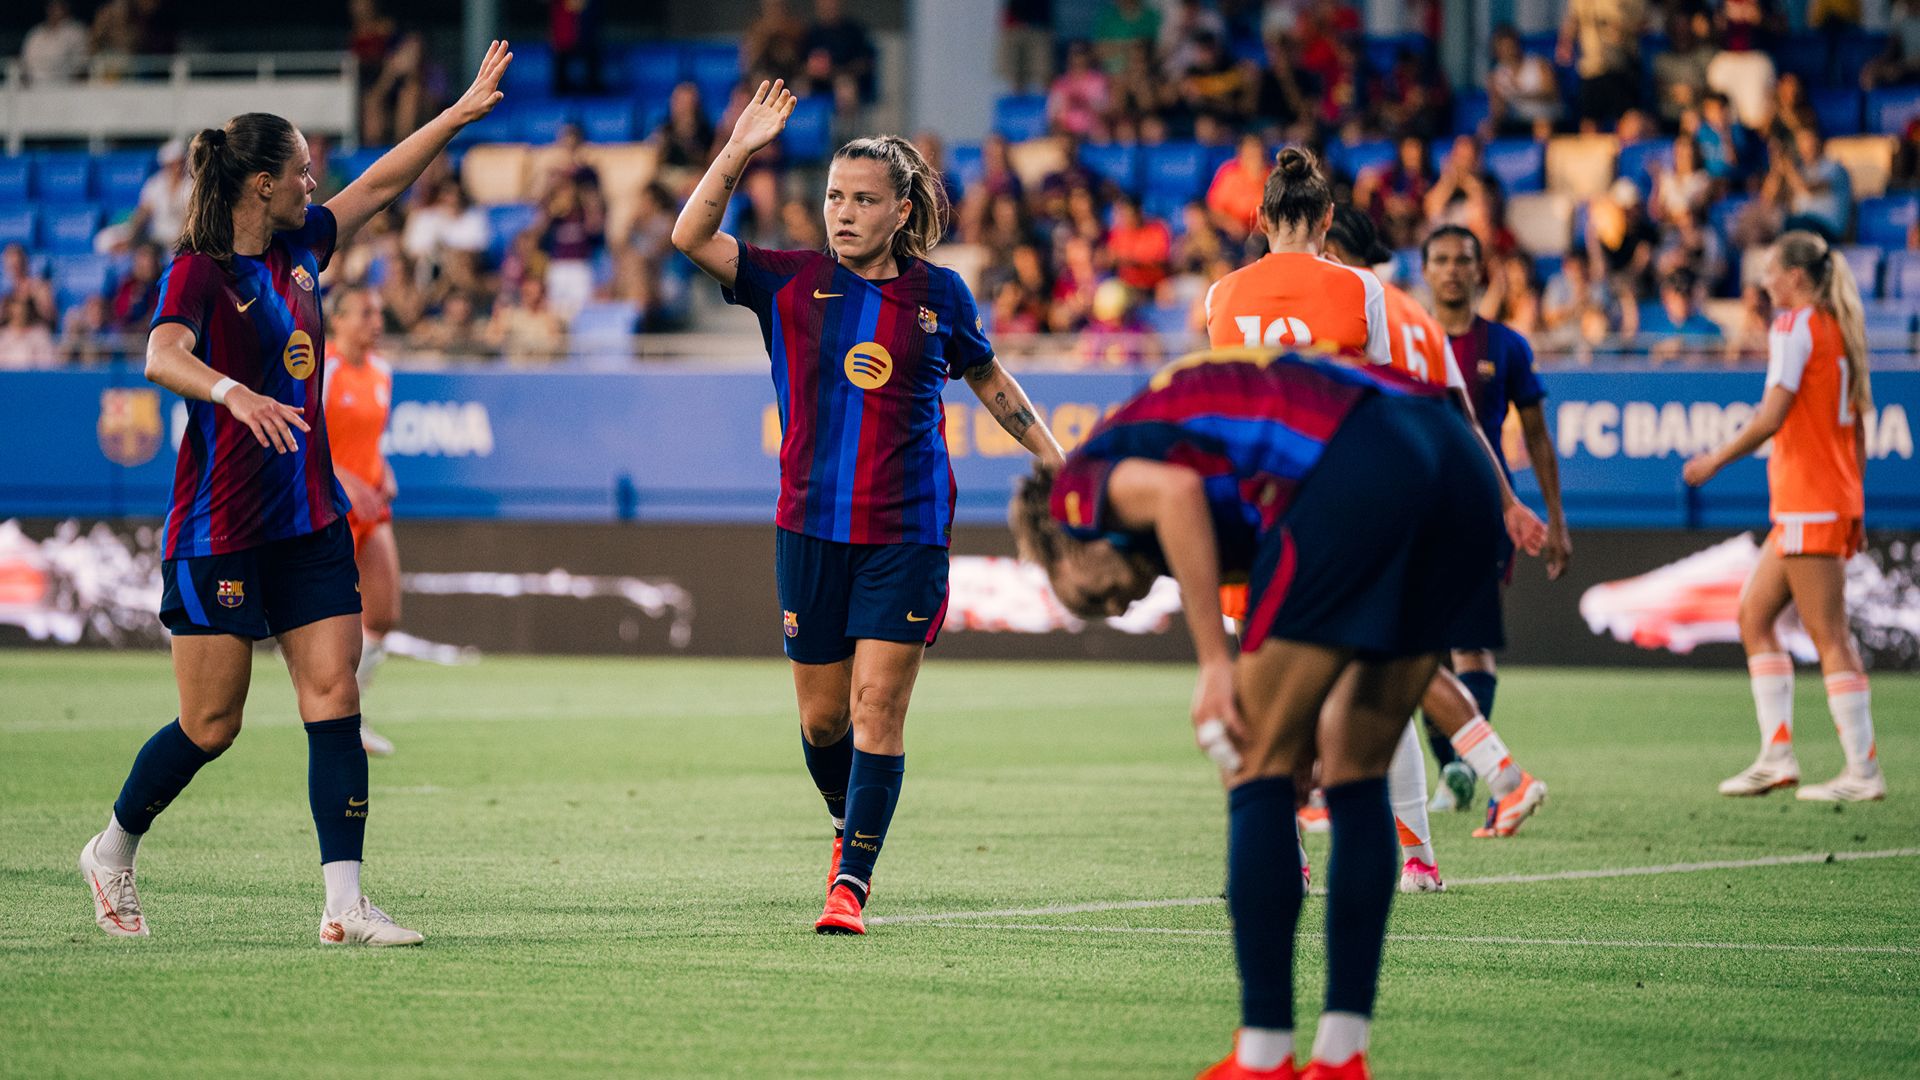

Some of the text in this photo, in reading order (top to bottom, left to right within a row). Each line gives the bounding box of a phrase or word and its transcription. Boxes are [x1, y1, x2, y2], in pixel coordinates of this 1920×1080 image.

[1557, 401, 1914, 459] FC BARCA
[851, 840, 877, 852] BARÇA
